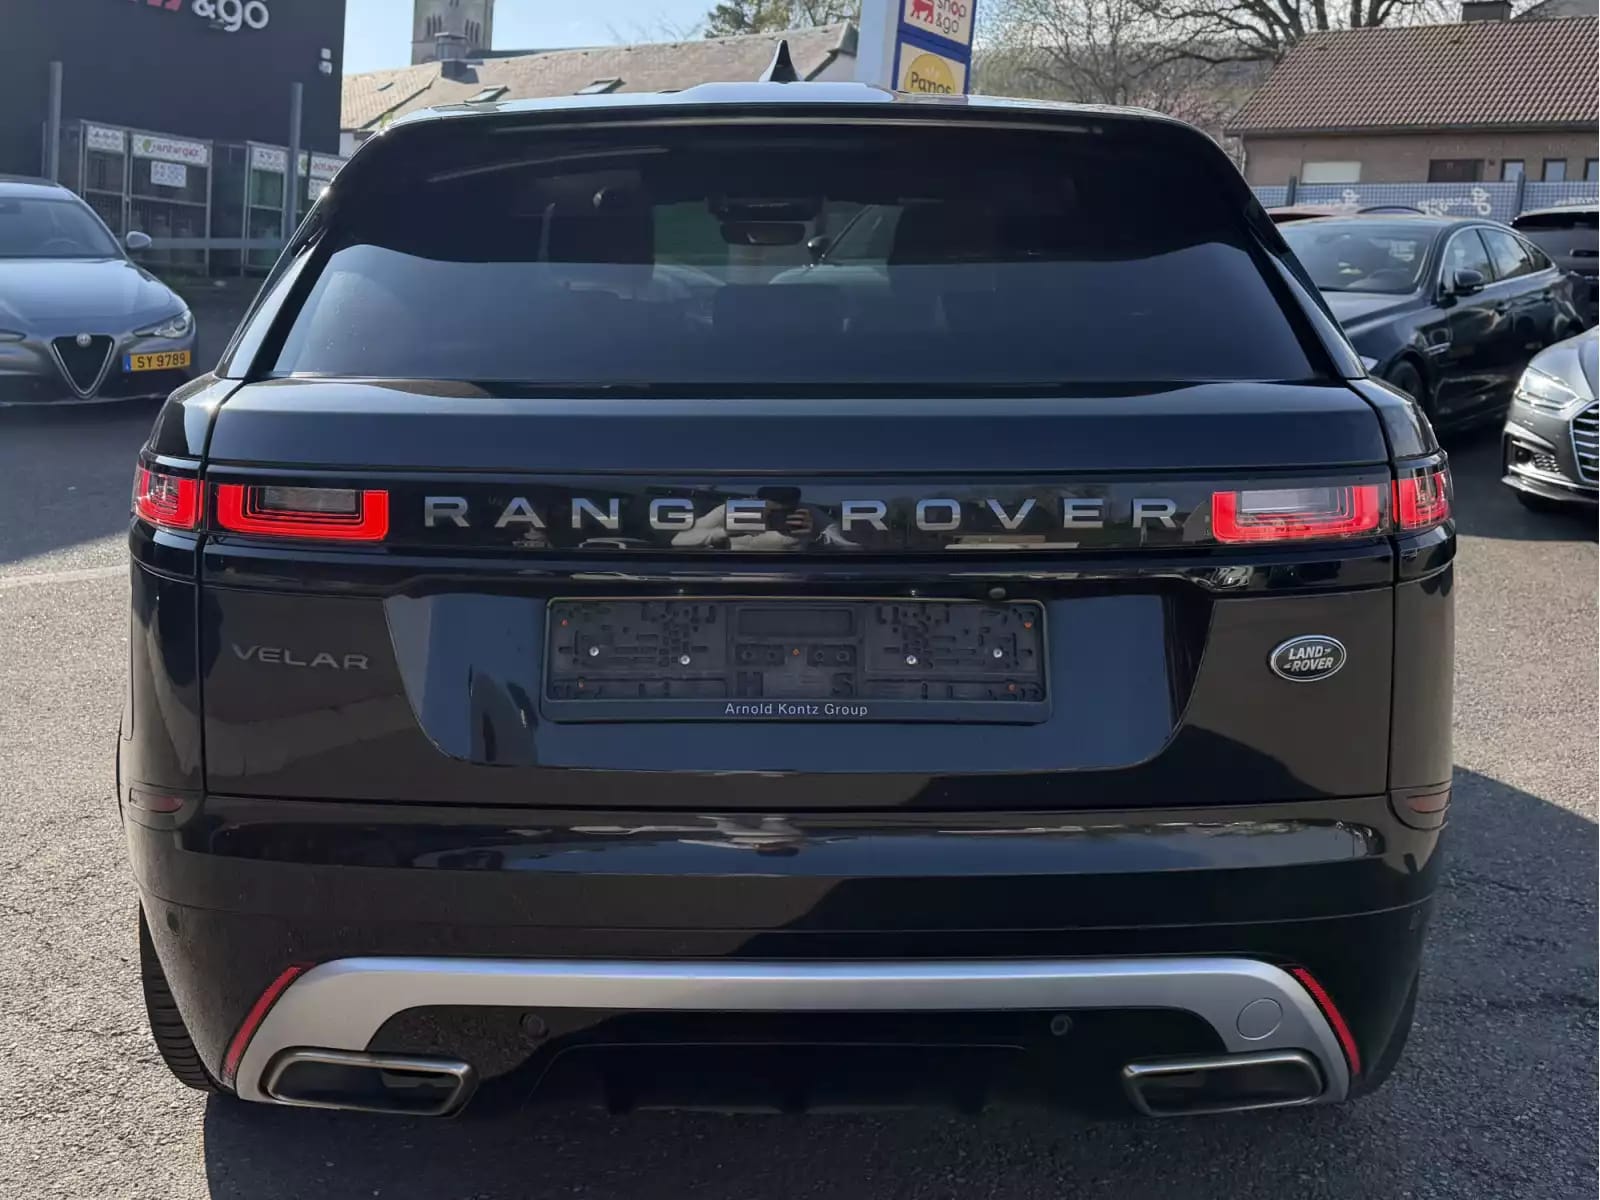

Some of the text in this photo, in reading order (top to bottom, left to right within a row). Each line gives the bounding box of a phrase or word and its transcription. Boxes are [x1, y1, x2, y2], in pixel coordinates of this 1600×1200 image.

[137, 352, 185, 368] SY 9789
[424, 496, 1177, 531] RANGE ROVER
[231, 643, 369, 670] VELAR
[1288, 645, 1324, 660] LAND
[1291, 657, 1334, 672] ROVER
[725, 703, 868, 717] Arnold Kontz Group
